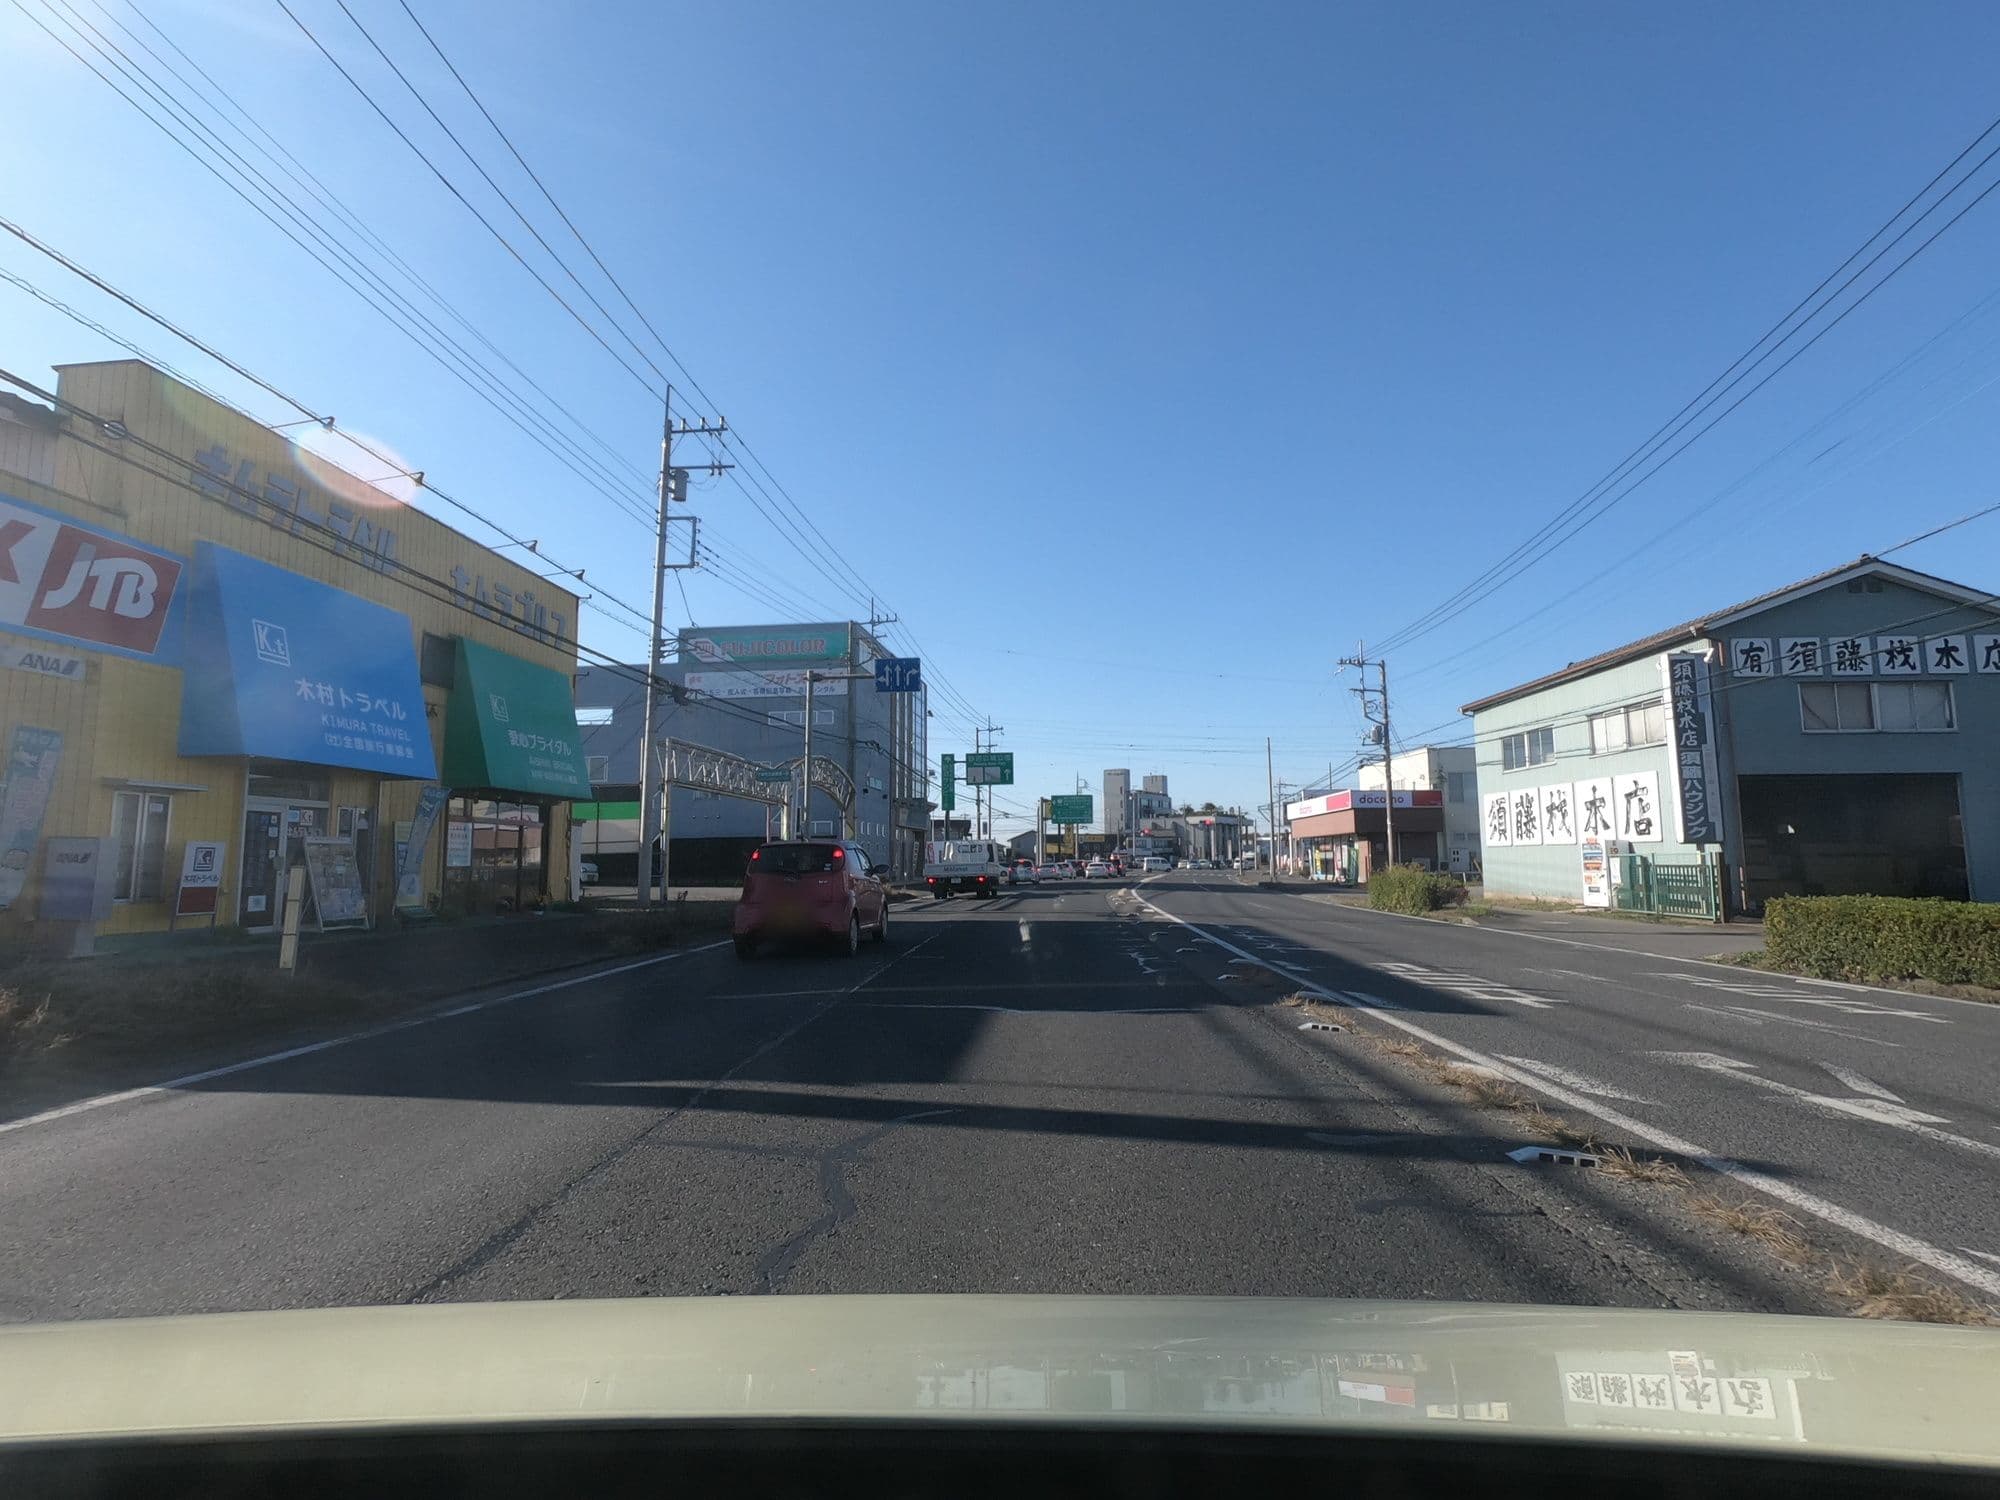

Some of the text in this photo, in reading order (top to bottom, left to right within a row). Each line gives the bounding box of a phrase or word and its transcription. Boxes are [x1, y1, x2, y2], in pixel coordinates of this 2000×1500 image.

[41, 541, 159, 619] JTB
[18, 652, 64, 675] ANA
[295, 677, 407, 721] 木村トラベル
[321, 713, 412, 742] KIMURA TRAVEL
